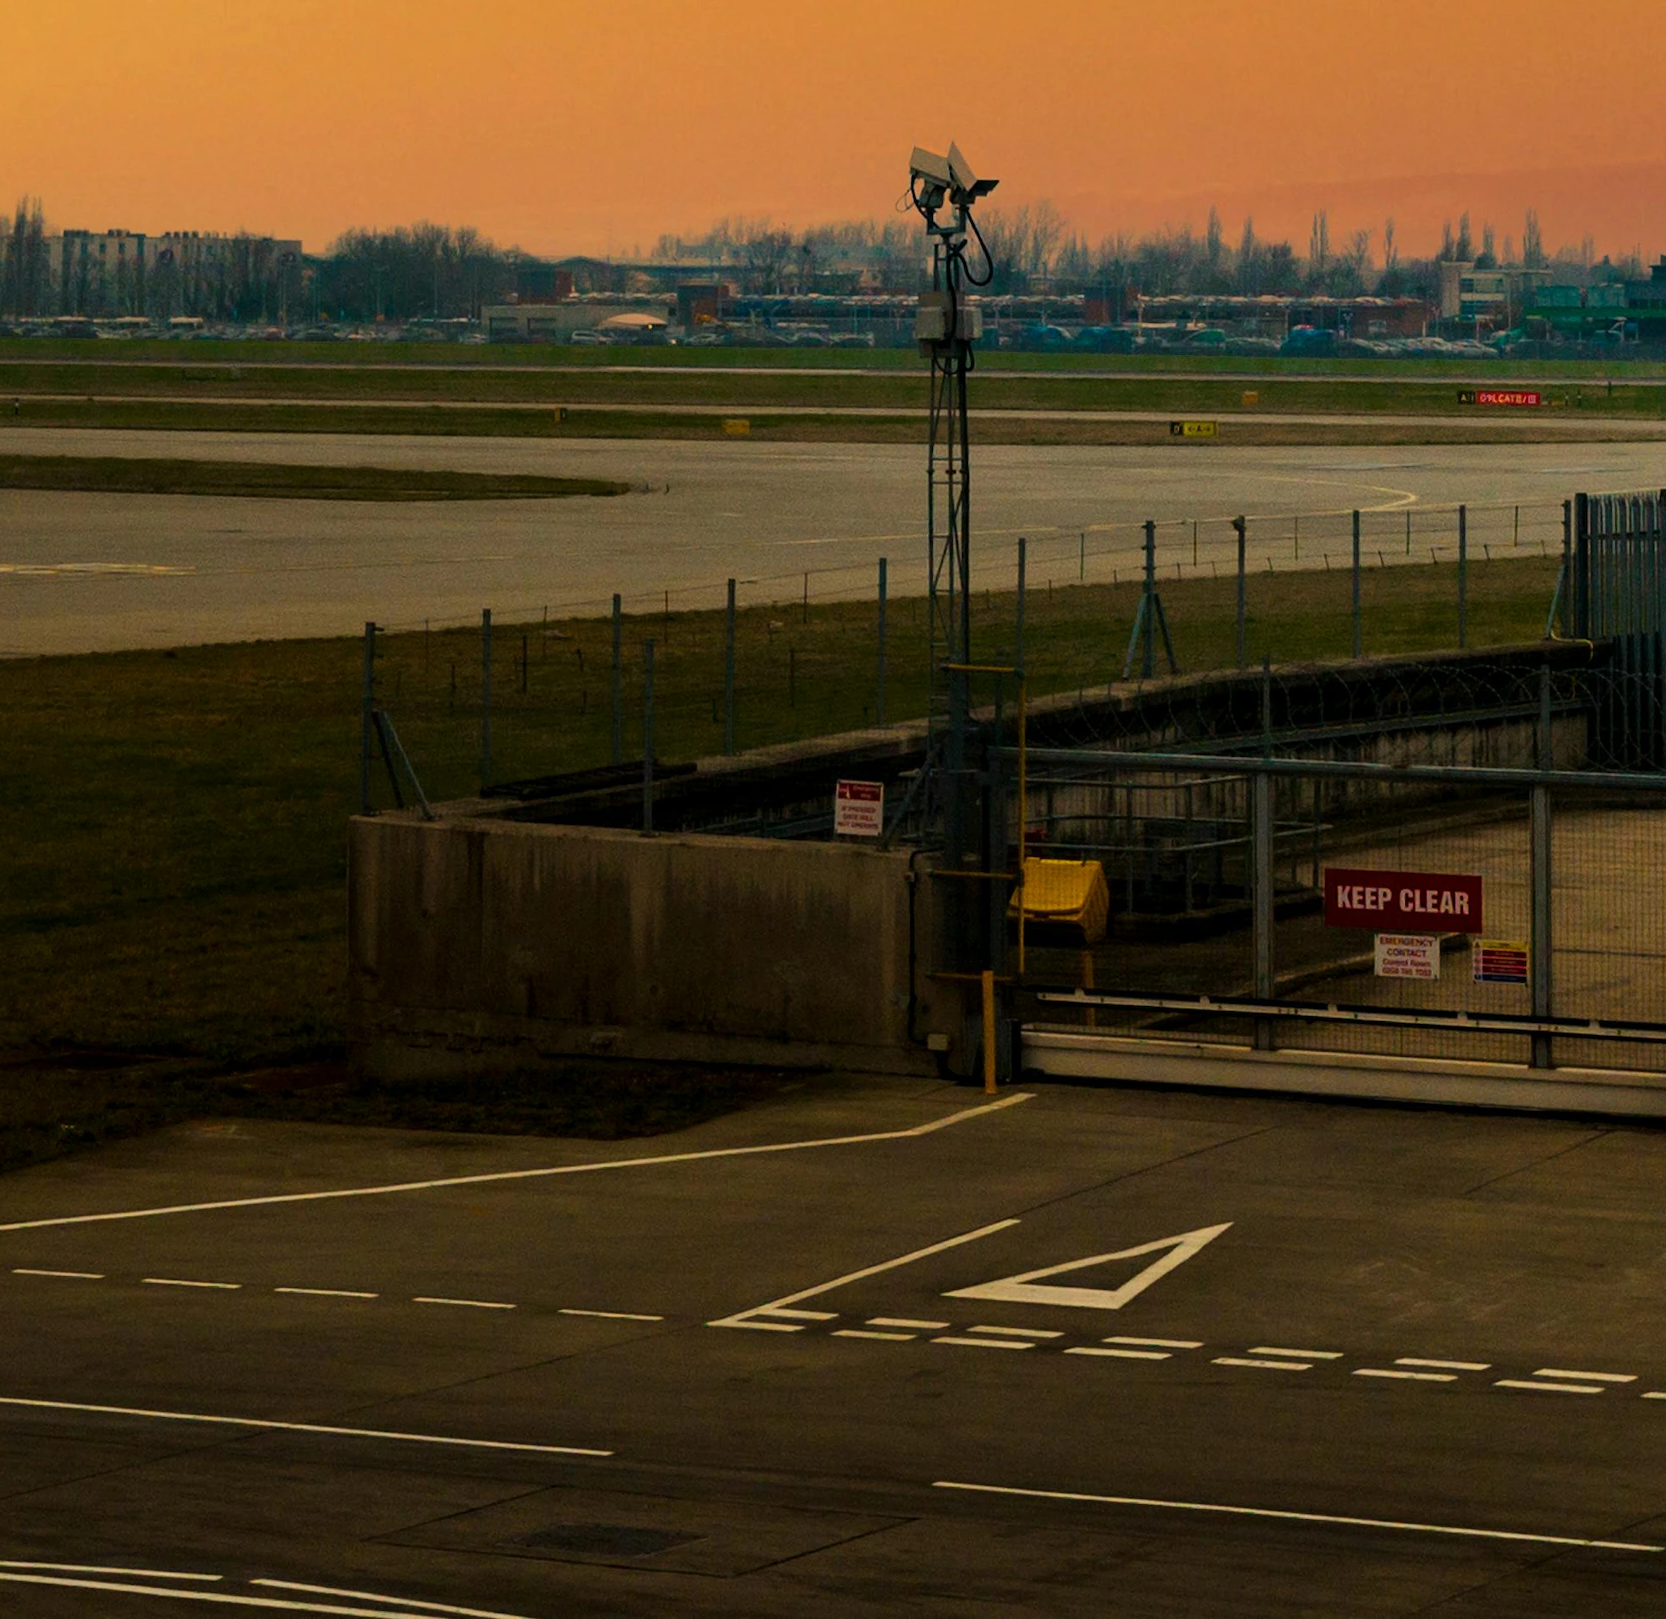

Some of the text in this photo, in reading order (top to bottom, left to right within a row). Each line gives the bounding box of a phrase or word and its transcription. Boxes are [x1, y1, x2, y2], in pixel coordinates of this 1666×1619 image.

[1337, 885, 1469, 915] KEEP CLEAR
[1380, 936, 1433, 947] EMERGENCY
[1386, 947, 1427, 958] CONTACT
